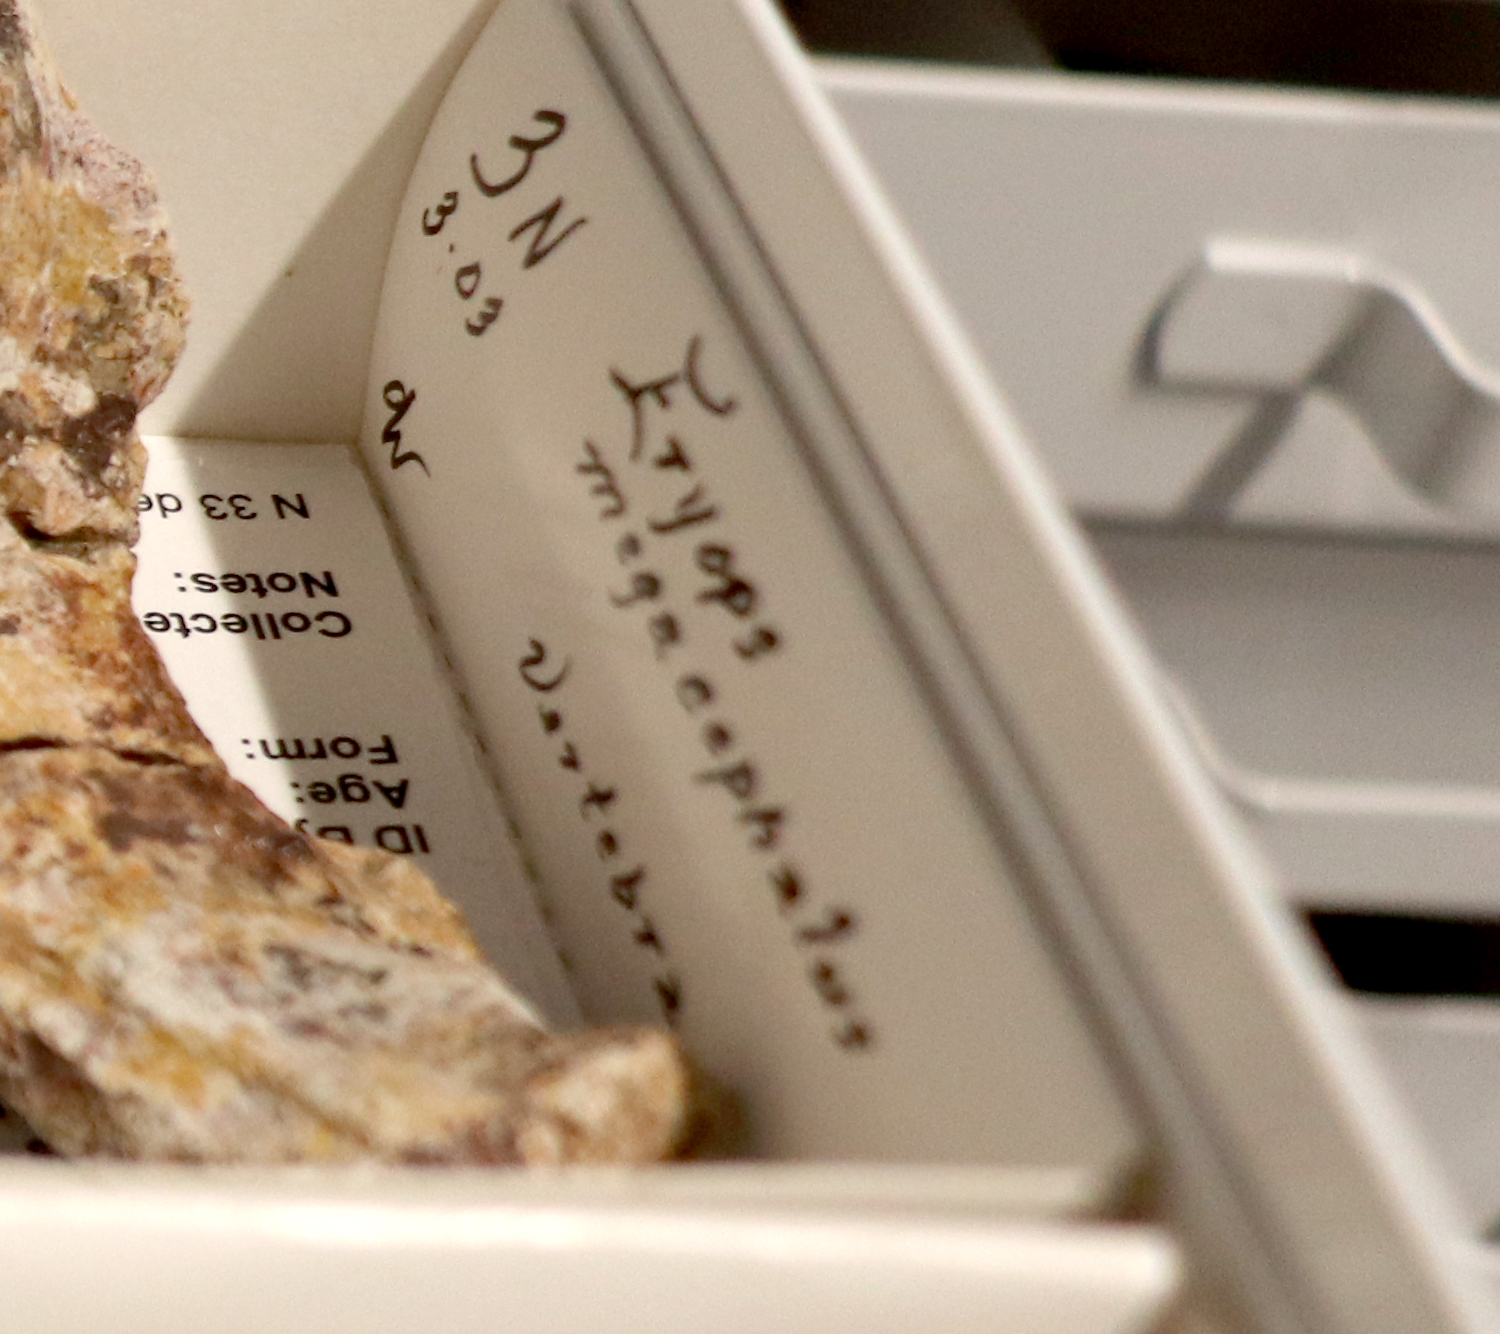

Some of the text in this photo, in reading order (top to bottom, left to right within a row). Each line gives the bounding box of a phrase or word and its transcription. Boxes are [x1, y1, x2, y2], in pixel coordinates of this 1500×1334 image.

[421, 189, 504, 338] 3.03
[469, 108, 780, 659] 3 N Eryops
[197, 493, 258, 521] 33
[269, 492, 312, 521] N
[173, 570, 340, 599] Notes:
[142, 610, 353, 641] Collecte
[240, 734, 399, 766] Form:
[289, 773, 411, 810] Age:
